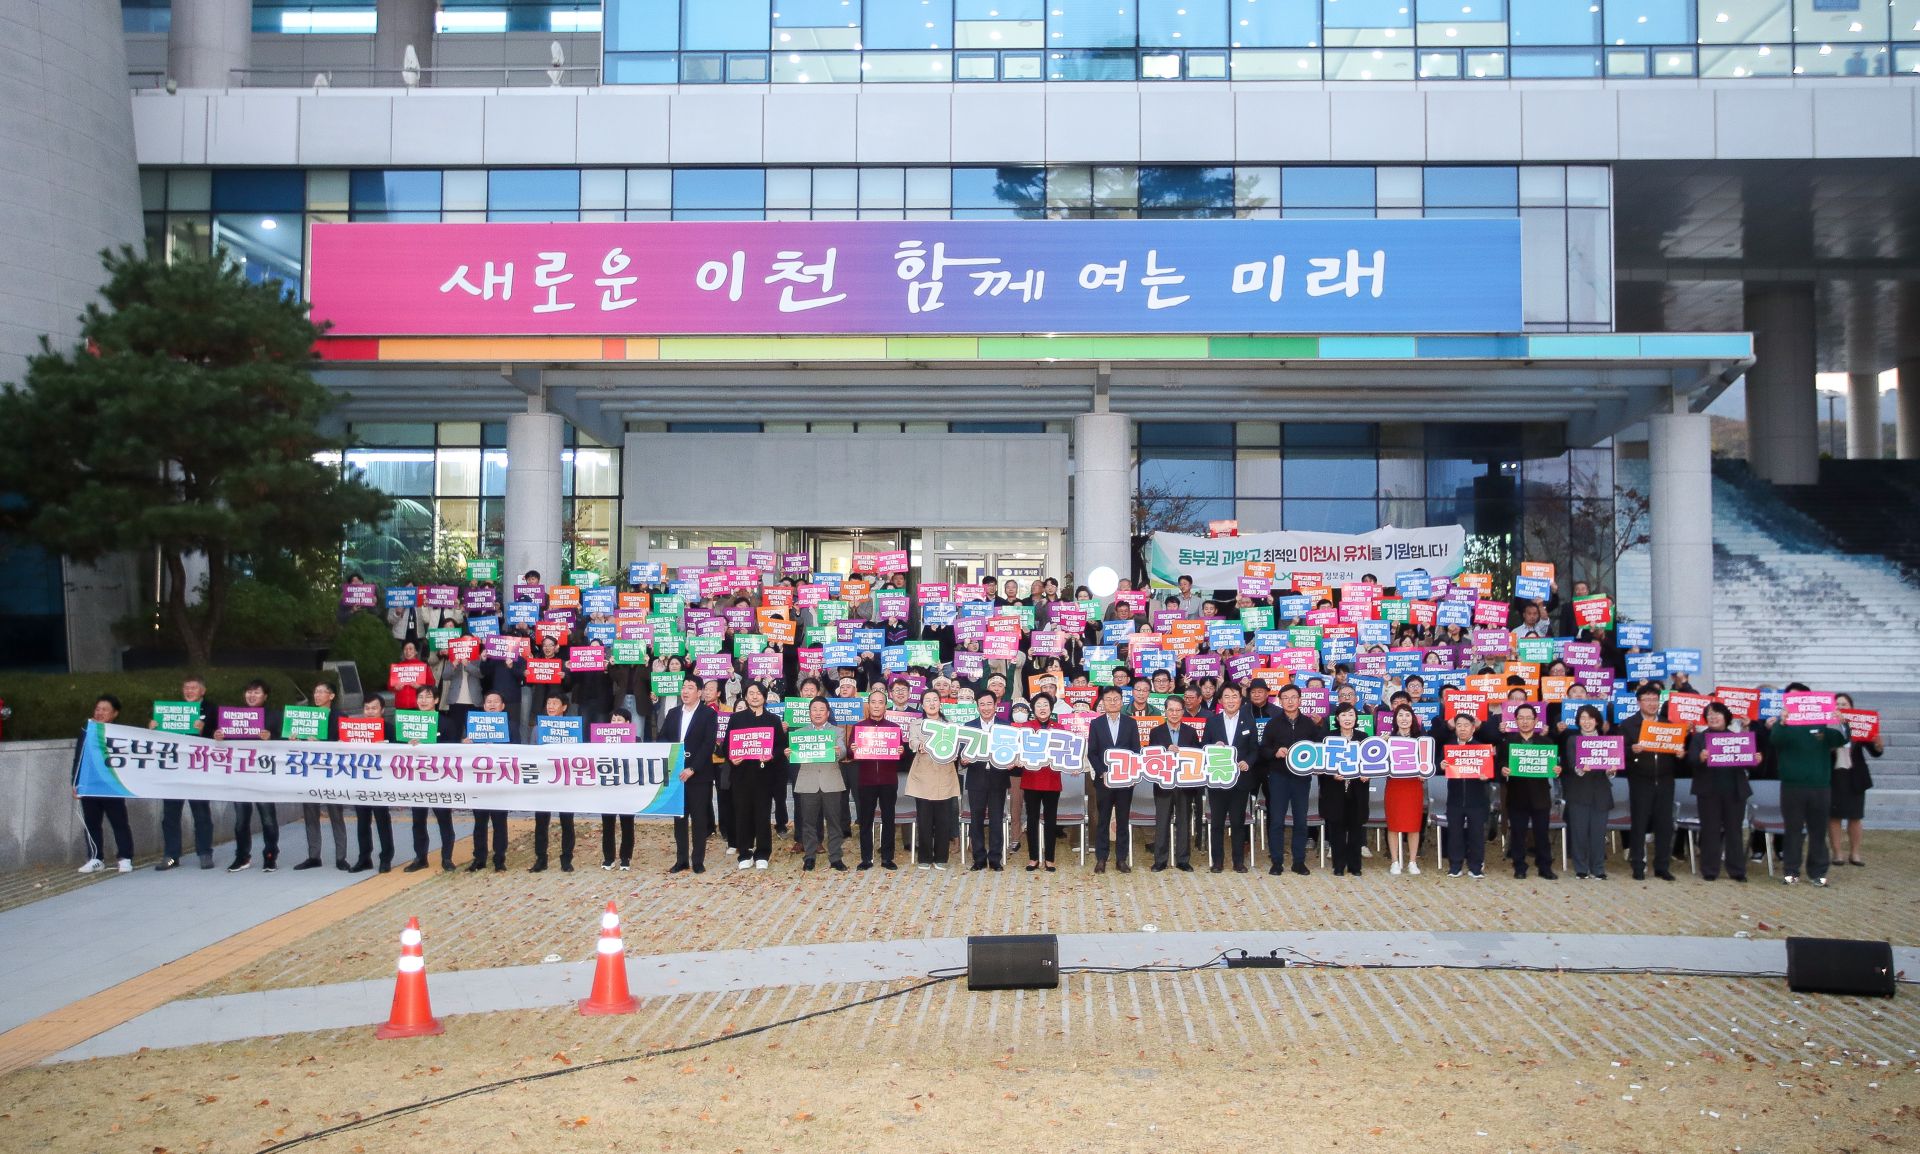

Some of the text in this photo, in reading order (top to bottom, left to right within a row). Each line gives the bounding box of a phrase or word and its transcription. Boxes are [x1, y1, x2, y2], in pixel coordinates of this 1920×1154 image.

[440, 239, 1386, 314] 새로운 이천 함께 여는 미래
[1179, 542, 1448, 566] 동부권 과학고 최적인 이천시 유치를 기원합니다!
[105, 738, 670, 786] 동부권 과학고의 최적지인 이천시 유치를 기원합니다
[924, 722, 1083, 767] 경기동부권
[1290, 736, 1430, 776] 이천으로!
[1109, 746, 1235, 784] 과학고를
[310, 790, 466, 804] 이천시 공간정보산업협회
